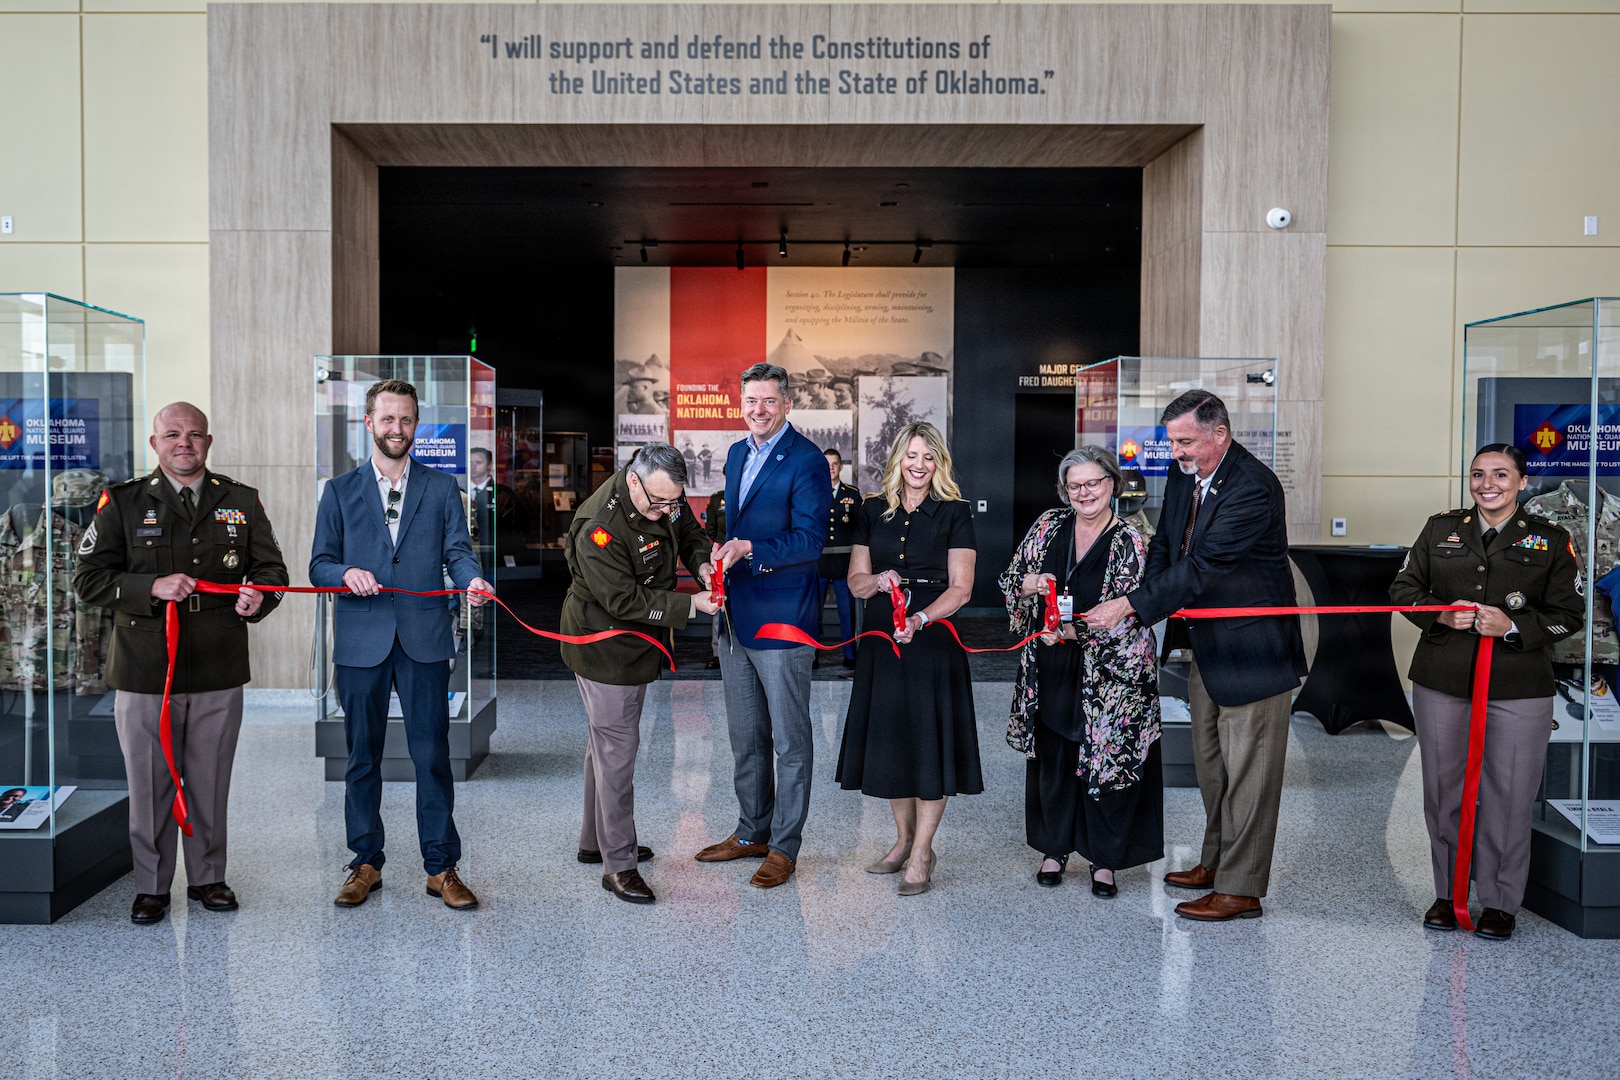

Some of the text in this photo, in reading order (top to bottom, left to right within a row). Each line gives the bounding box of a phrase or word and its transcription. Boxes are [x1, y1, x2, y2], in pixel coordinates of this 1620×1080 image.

[480, 34, 991, 64] “I will support and defend the Constitutions of
[549, 69, 1055, 95] the United States and the State of Oklahoma.”
[785, 289, 809, 298] Section
[823, 290, 836, 298] The
[837, 289, 874, 301] Legislature
[875, 290, 891, 298] shall
[890, 290, 917, 301] provide
[916, 289, 927, 301] for
[823, 303, 863, 313] disciplining,
[864, 303, 889, 314] arming,
[891, 303, 934, 314] maintaining,
[785, 315, 799, 323] and
[799, 316, 830, 326] equipping
[831, 315, 841, 323] the
[870, 315, 878, 326] of
[878, 315, 889, 323] the
[890, 315, 909, 324] State.
[1039, 364, 1068, 375] MAJOR
[1018, 376, 1040, 387] FRED
[676, 384, 719, 392] FOUNDING THE
[676, 394, 730, 405] OKLAHOMA
[676, 407, 744, 419] NATIONAL GUA
[26, 434, 86, 445] MUSEUM
[415, 449, 457, 457] MUSEUM
